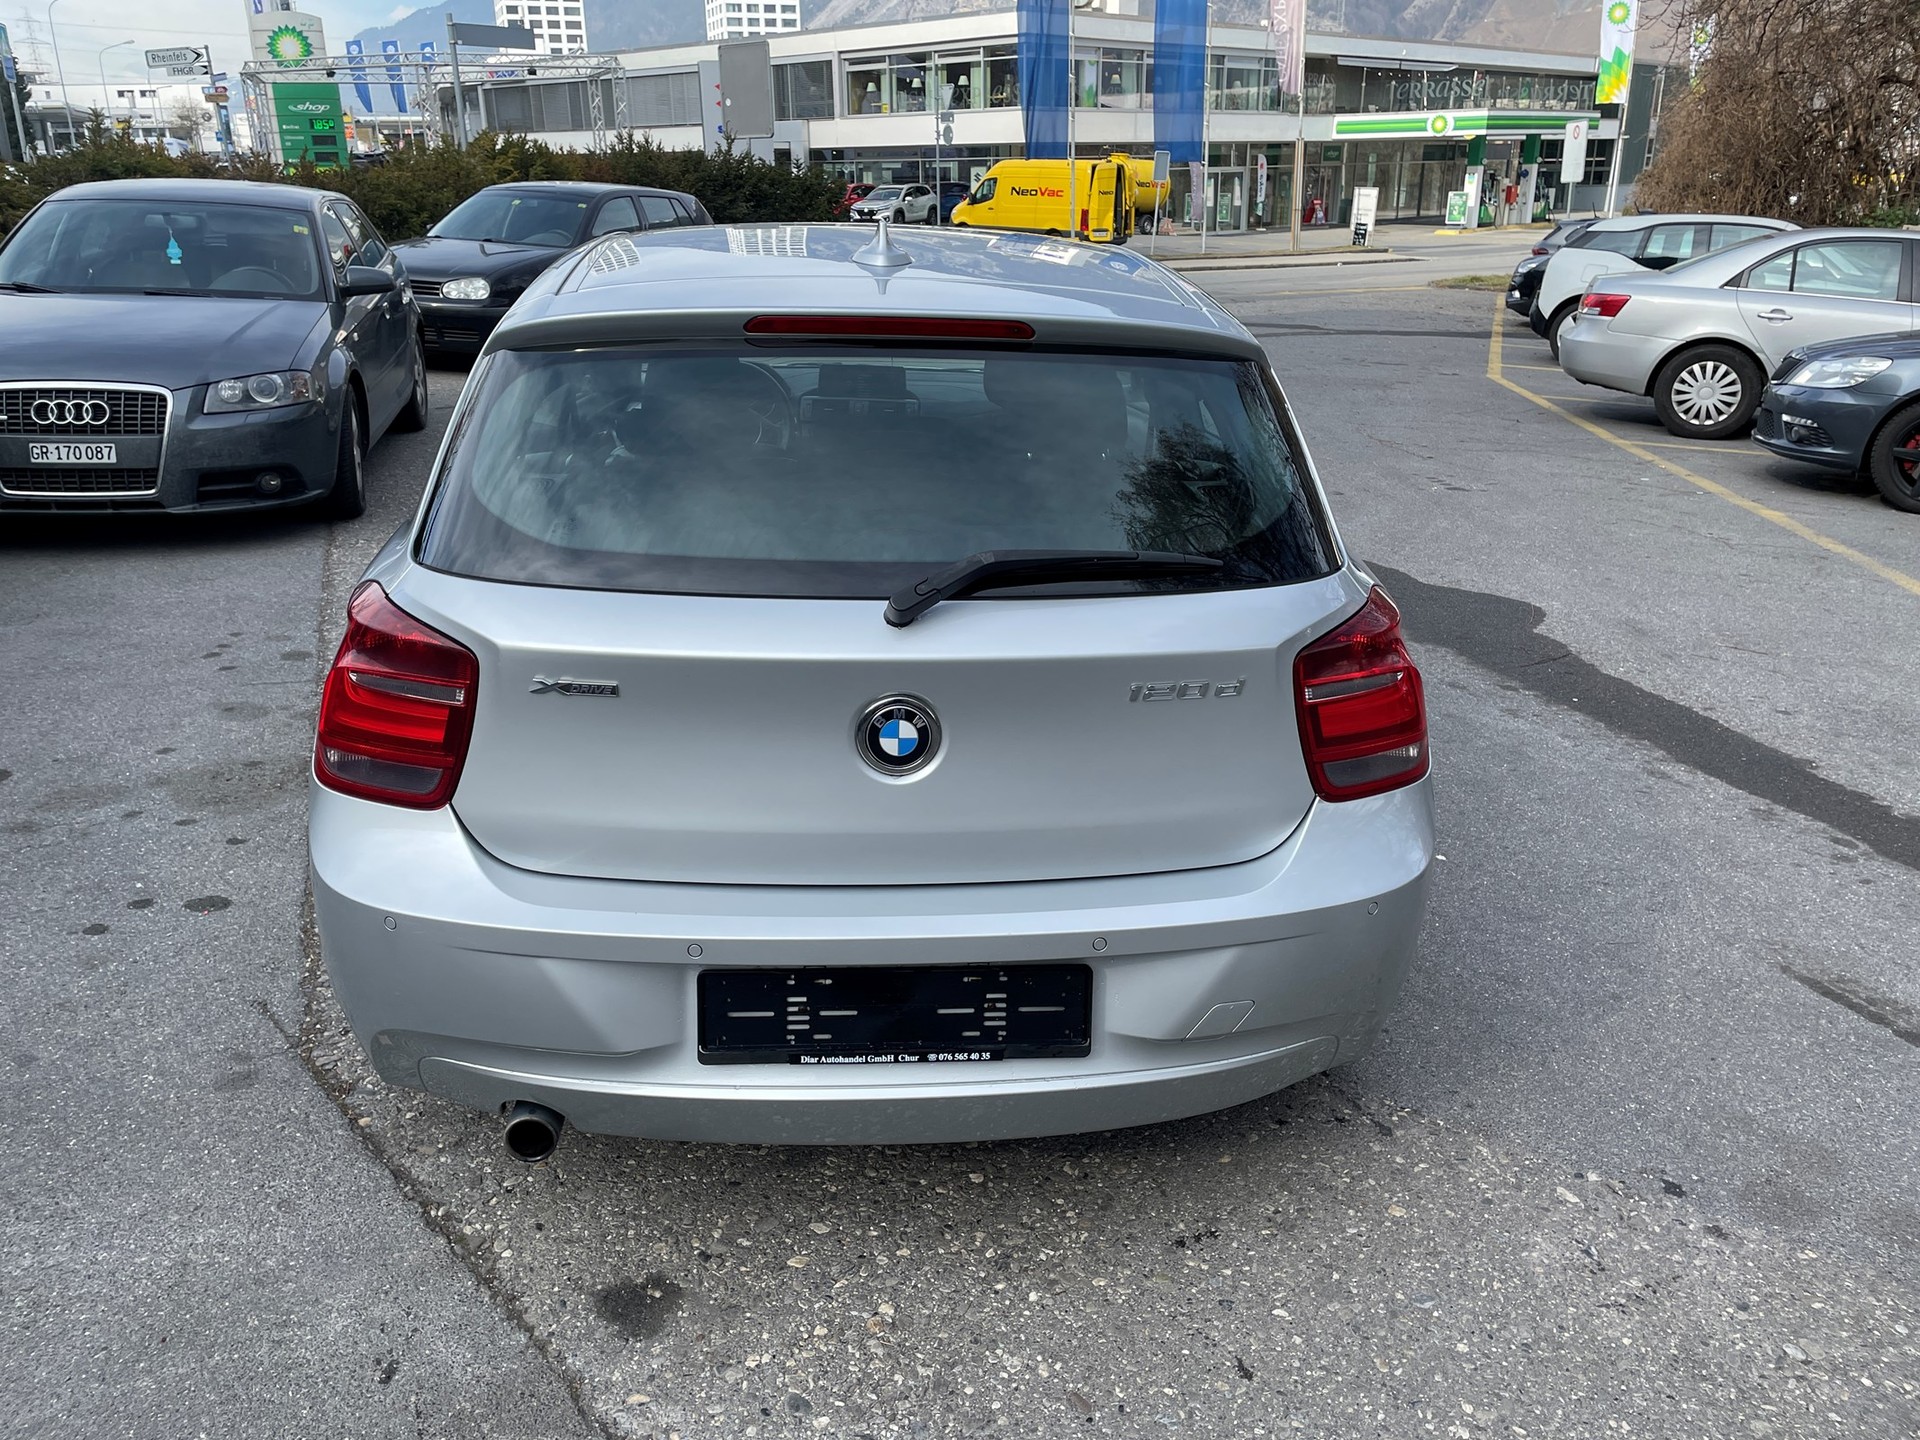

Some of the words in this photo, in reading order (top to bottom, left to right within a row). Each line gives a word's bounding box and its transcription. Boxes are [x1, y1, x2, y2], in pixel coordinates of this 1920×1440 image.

[151, 51, 188, 64] Rheinfels
[172, 66, 195, 76] FHGR
[295, 101, 331, 114] shop
[1010, 186, 1064, 198] NeoVac
[873, 708, 926, 729] BMW
[800, 1055, 819, 1064] Diar
[820, 1055, 866, 1063] Autohandel
[867, 1054, 894, 1063] GmbH
[898, 1054, 920, 1062] Chur
[938, 1053, 953, 1061] 076
[954, 1053, 968, 1061] 565
[970, 1052, 980, 1060] 40
[981, 1052, 990, 1060] 35
